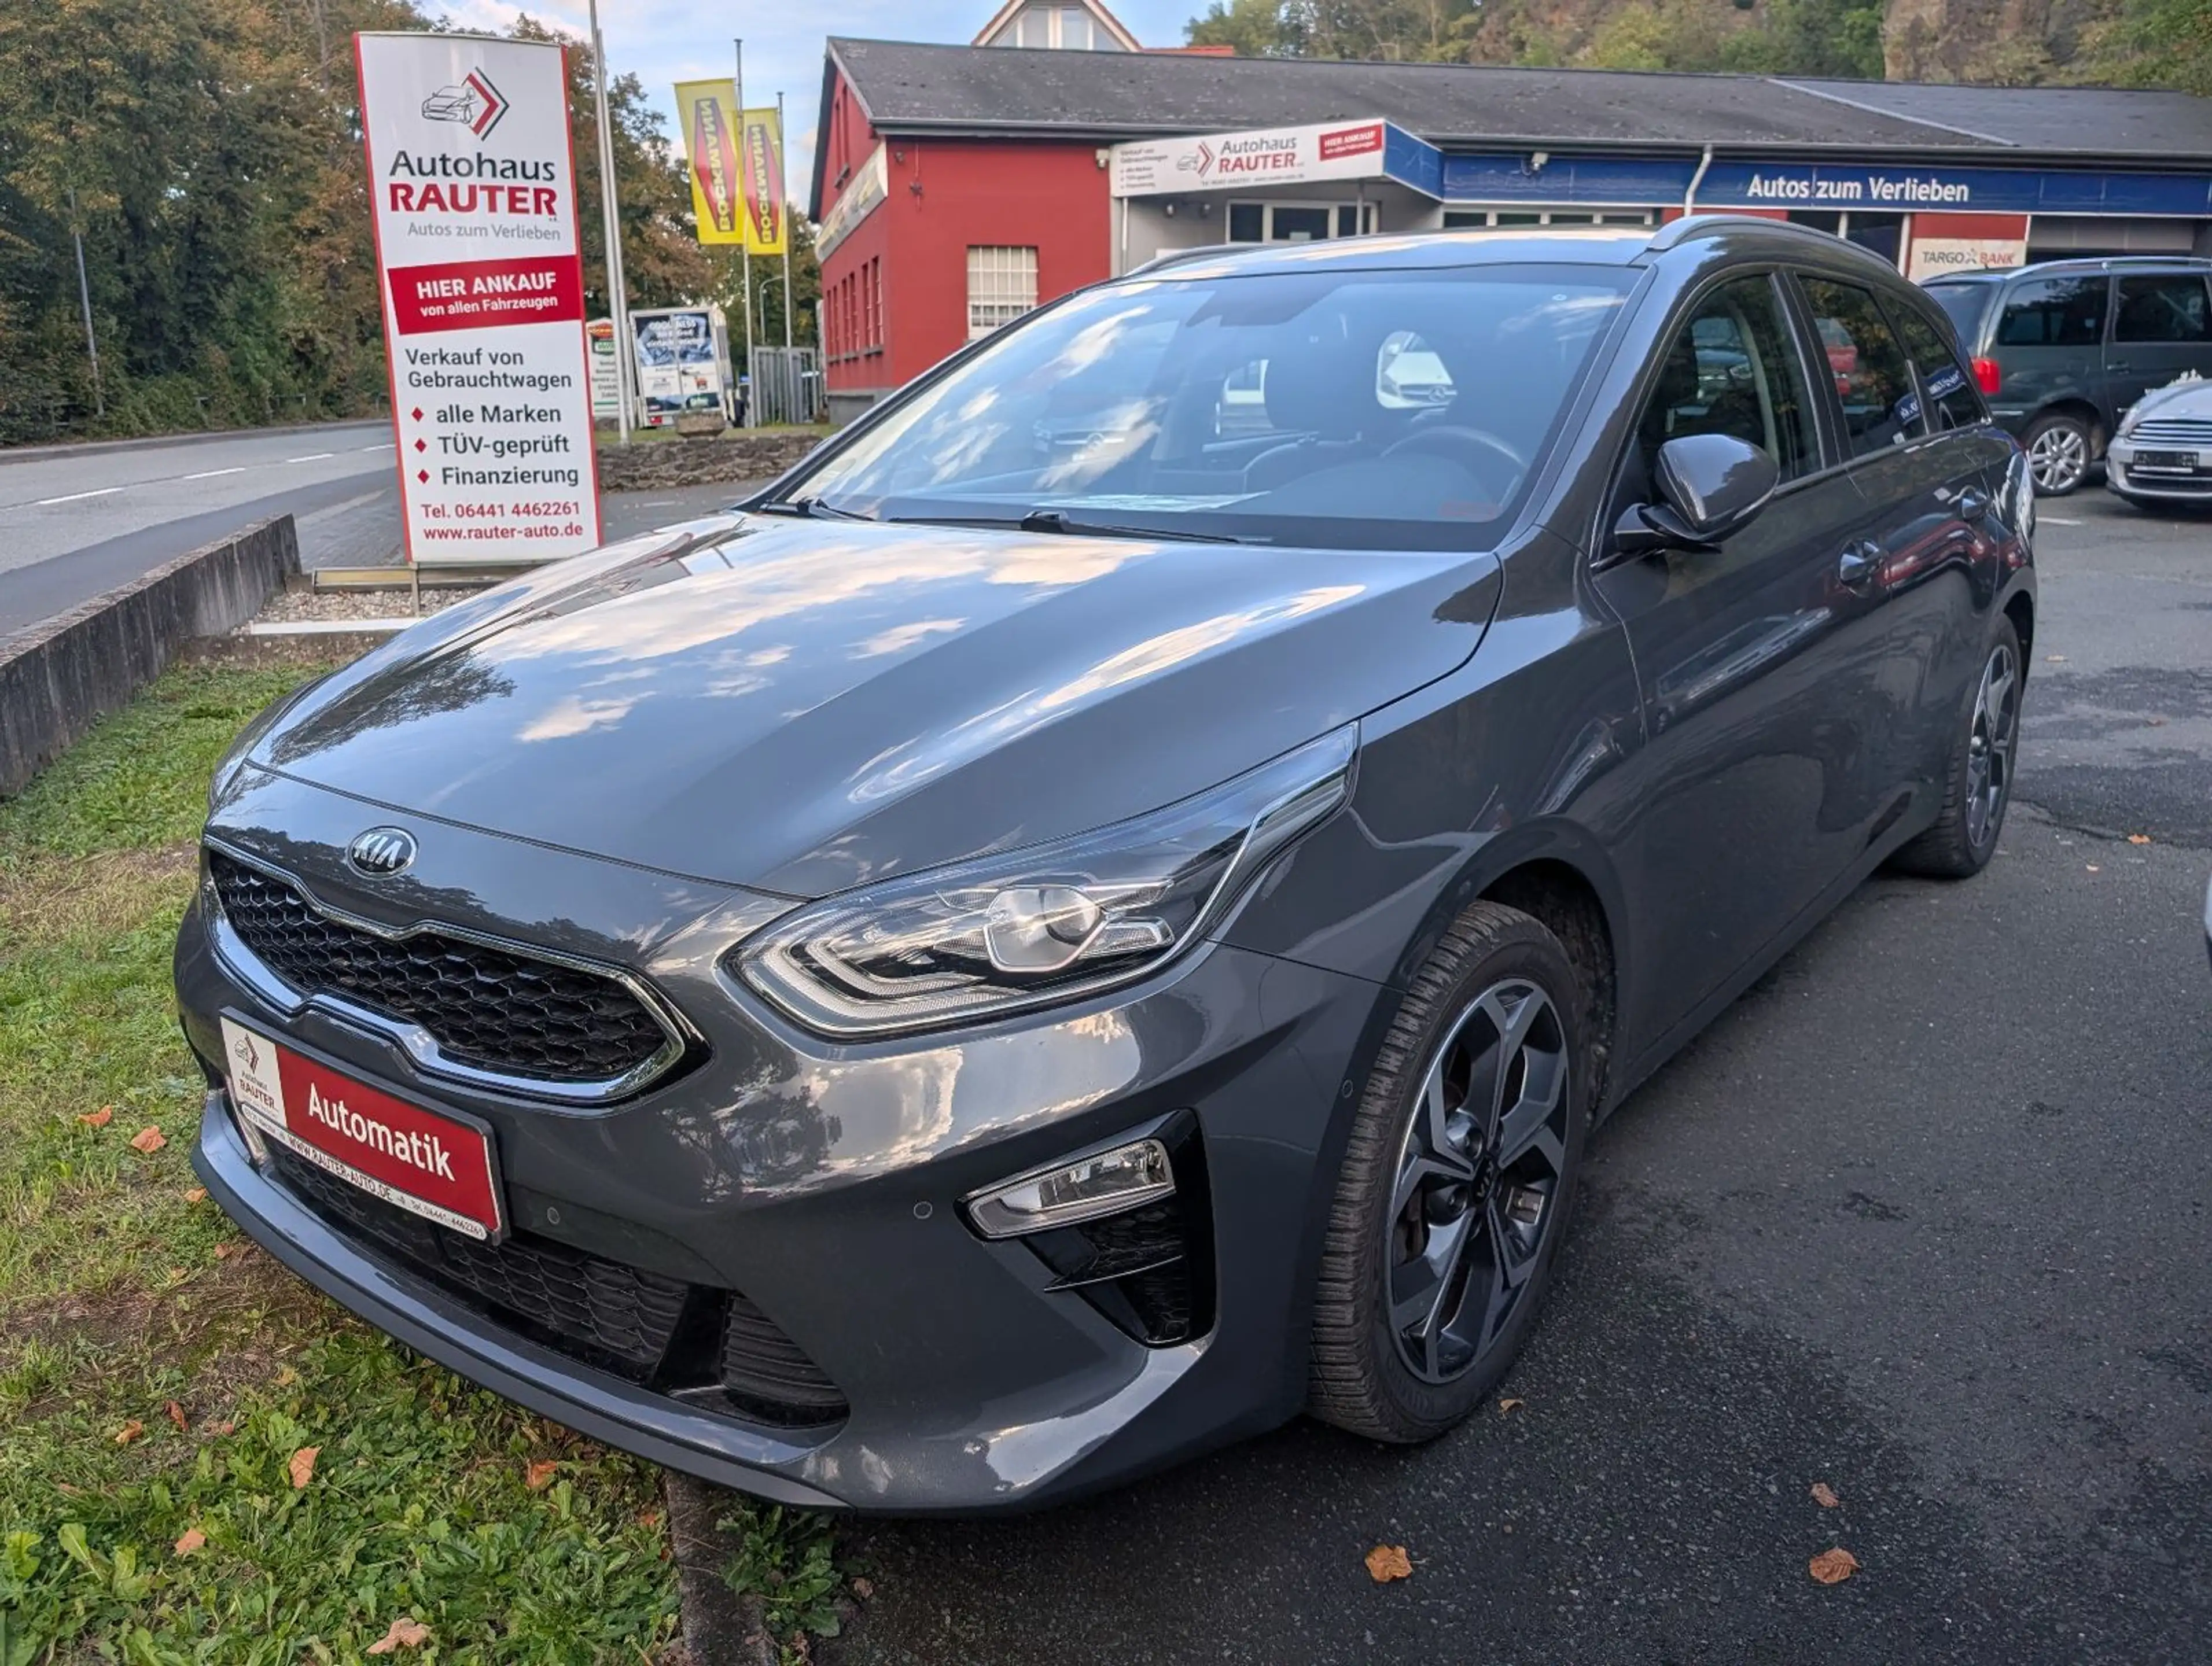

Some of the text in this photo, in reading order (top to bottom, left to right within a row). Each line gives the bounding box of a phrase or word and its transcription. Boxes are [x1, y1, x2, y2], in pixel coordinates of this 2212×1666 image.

[1220, 137, 1297, 154] Autohaus
[389, 150, 555, 181] Autohaus
[1219, 152, 1296, 173] RAUTER
[1747, 174, 1970, 202] Autos zum Verlieben
[390, 183, 557, 216] RAUTER
[407, 222, 561, 241] Autos zum Verlieben
[417, 272, 557, 300] HIER ANKAUF
[419, 295, 558, 317] von allen Fahrzeugen
[406, 348, 524, 366] Verkauf von
[408, 371, 572, 391] Gebrauchtwagen
[436, 404, 561, 423] alle Marken
[438, 433, 570, 458] TÜV-geprüft
[441, 466, 579, 486] Finanzierung
[421, 501, 580, 519] Tel. 06441 4462261
[423, 522, 583, 540] www.rauter-auto.de
[354, 833, 403, 869] KIA
[308, 1082, 456, 1181] Automatik
